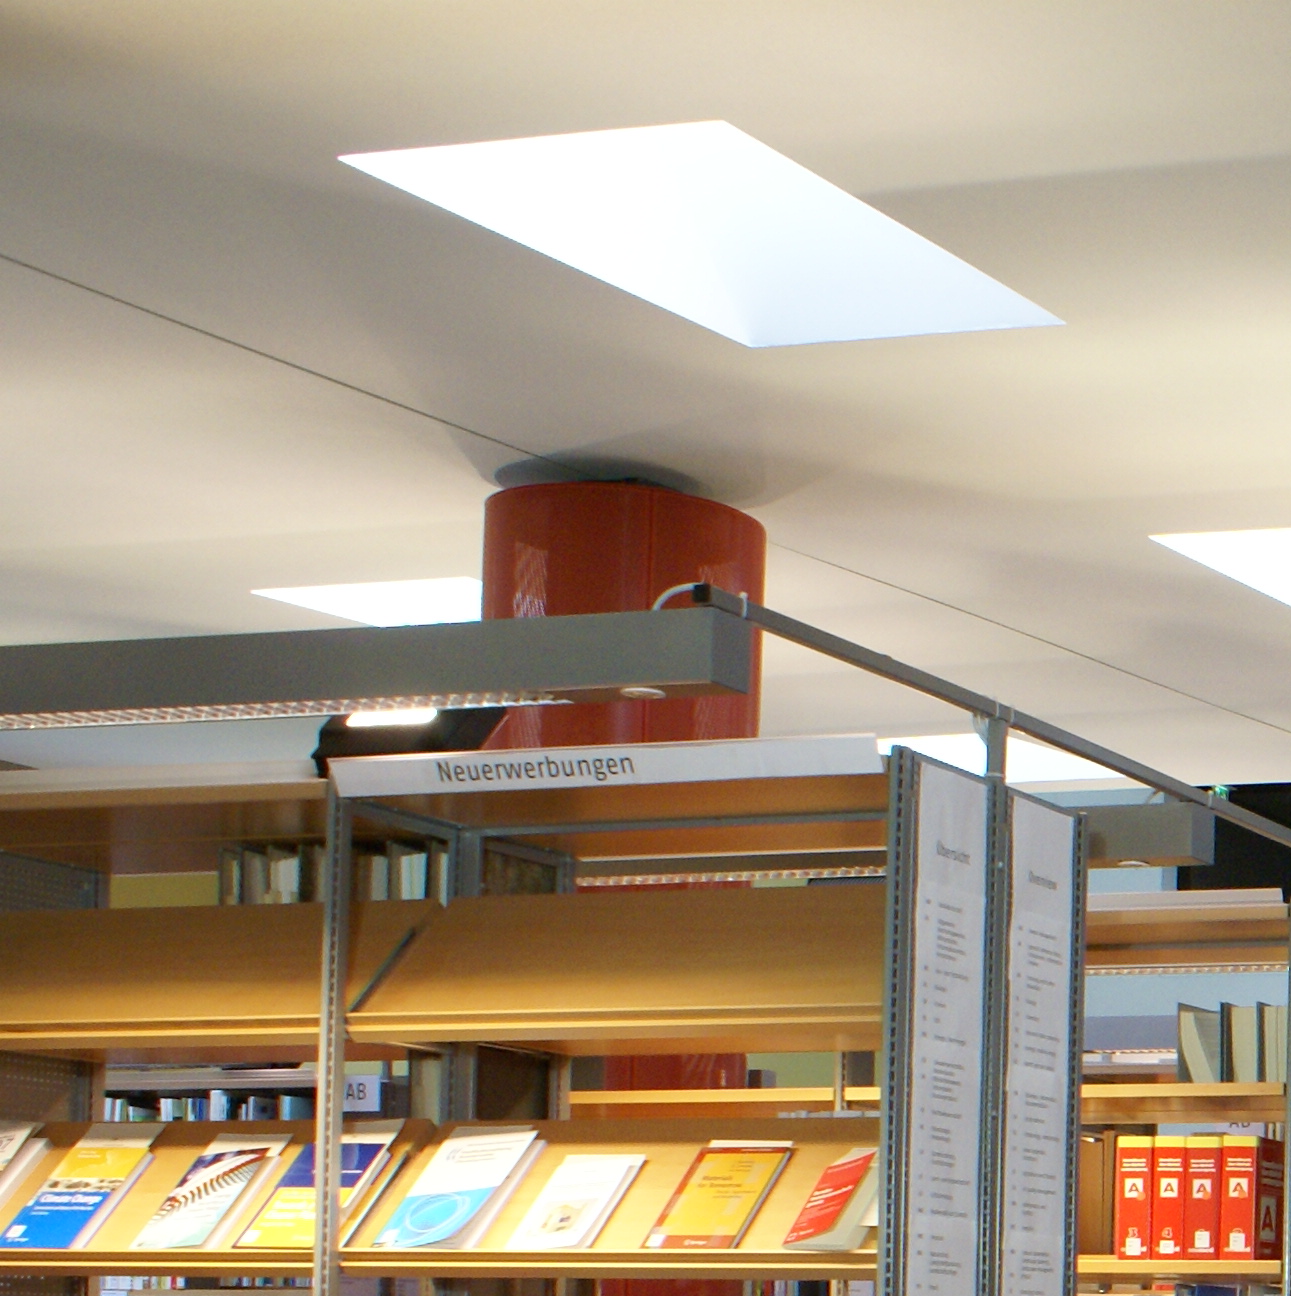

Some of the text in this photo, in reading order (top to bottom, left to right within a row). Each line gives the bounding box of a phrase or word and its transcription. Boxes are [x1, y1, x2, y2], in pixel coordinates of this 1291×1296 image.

[437, 755, 634, 782] Neuerwerbungen
[346, 1083, 367, 1100] AB
[1128, 1182, 1139, 1193] A
[1163, 1182, 1175, 1193] A
